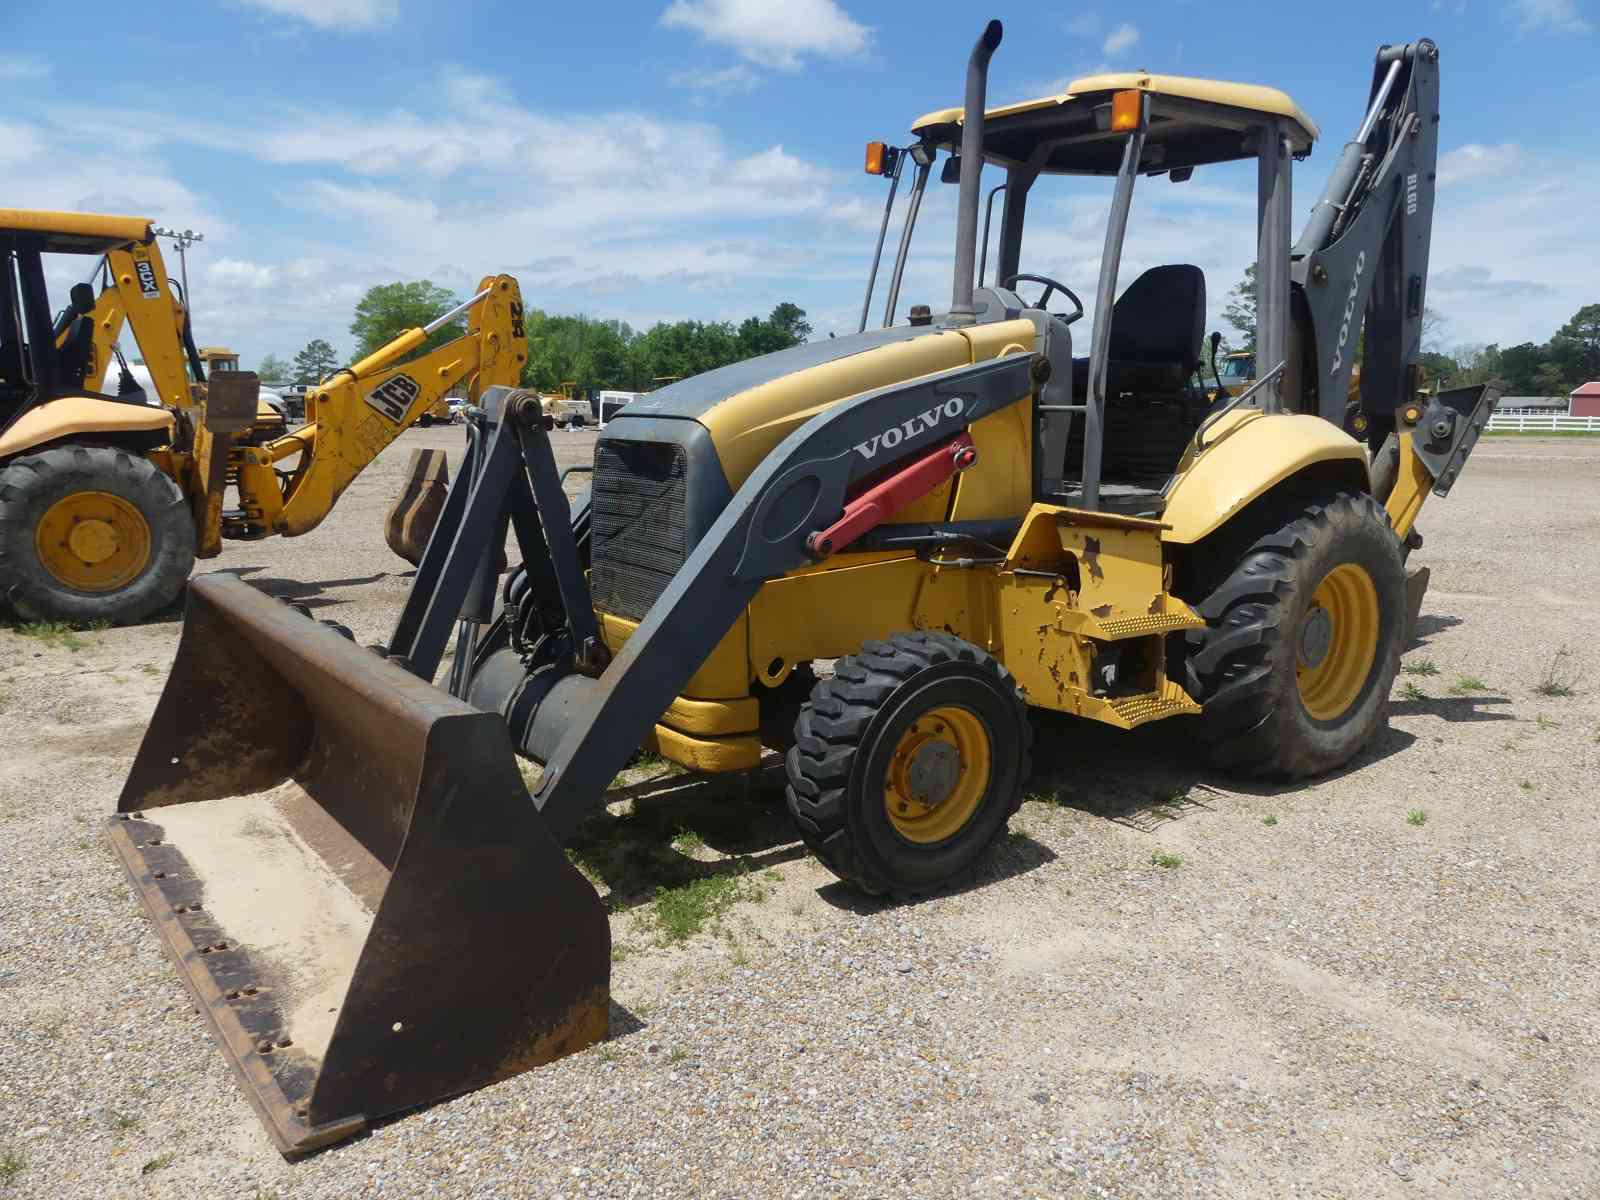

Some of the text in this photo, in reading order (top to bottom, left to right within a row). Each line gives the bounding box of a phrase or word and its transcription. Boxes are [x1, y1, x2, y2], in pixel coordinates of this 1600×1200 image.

[137, 262, 157, 291] 3CX
[1330, 250, 1365, 375] VOLVO
[371, 377, 417, 420] JCB
[853, 397, 964, 460] VOLVO
